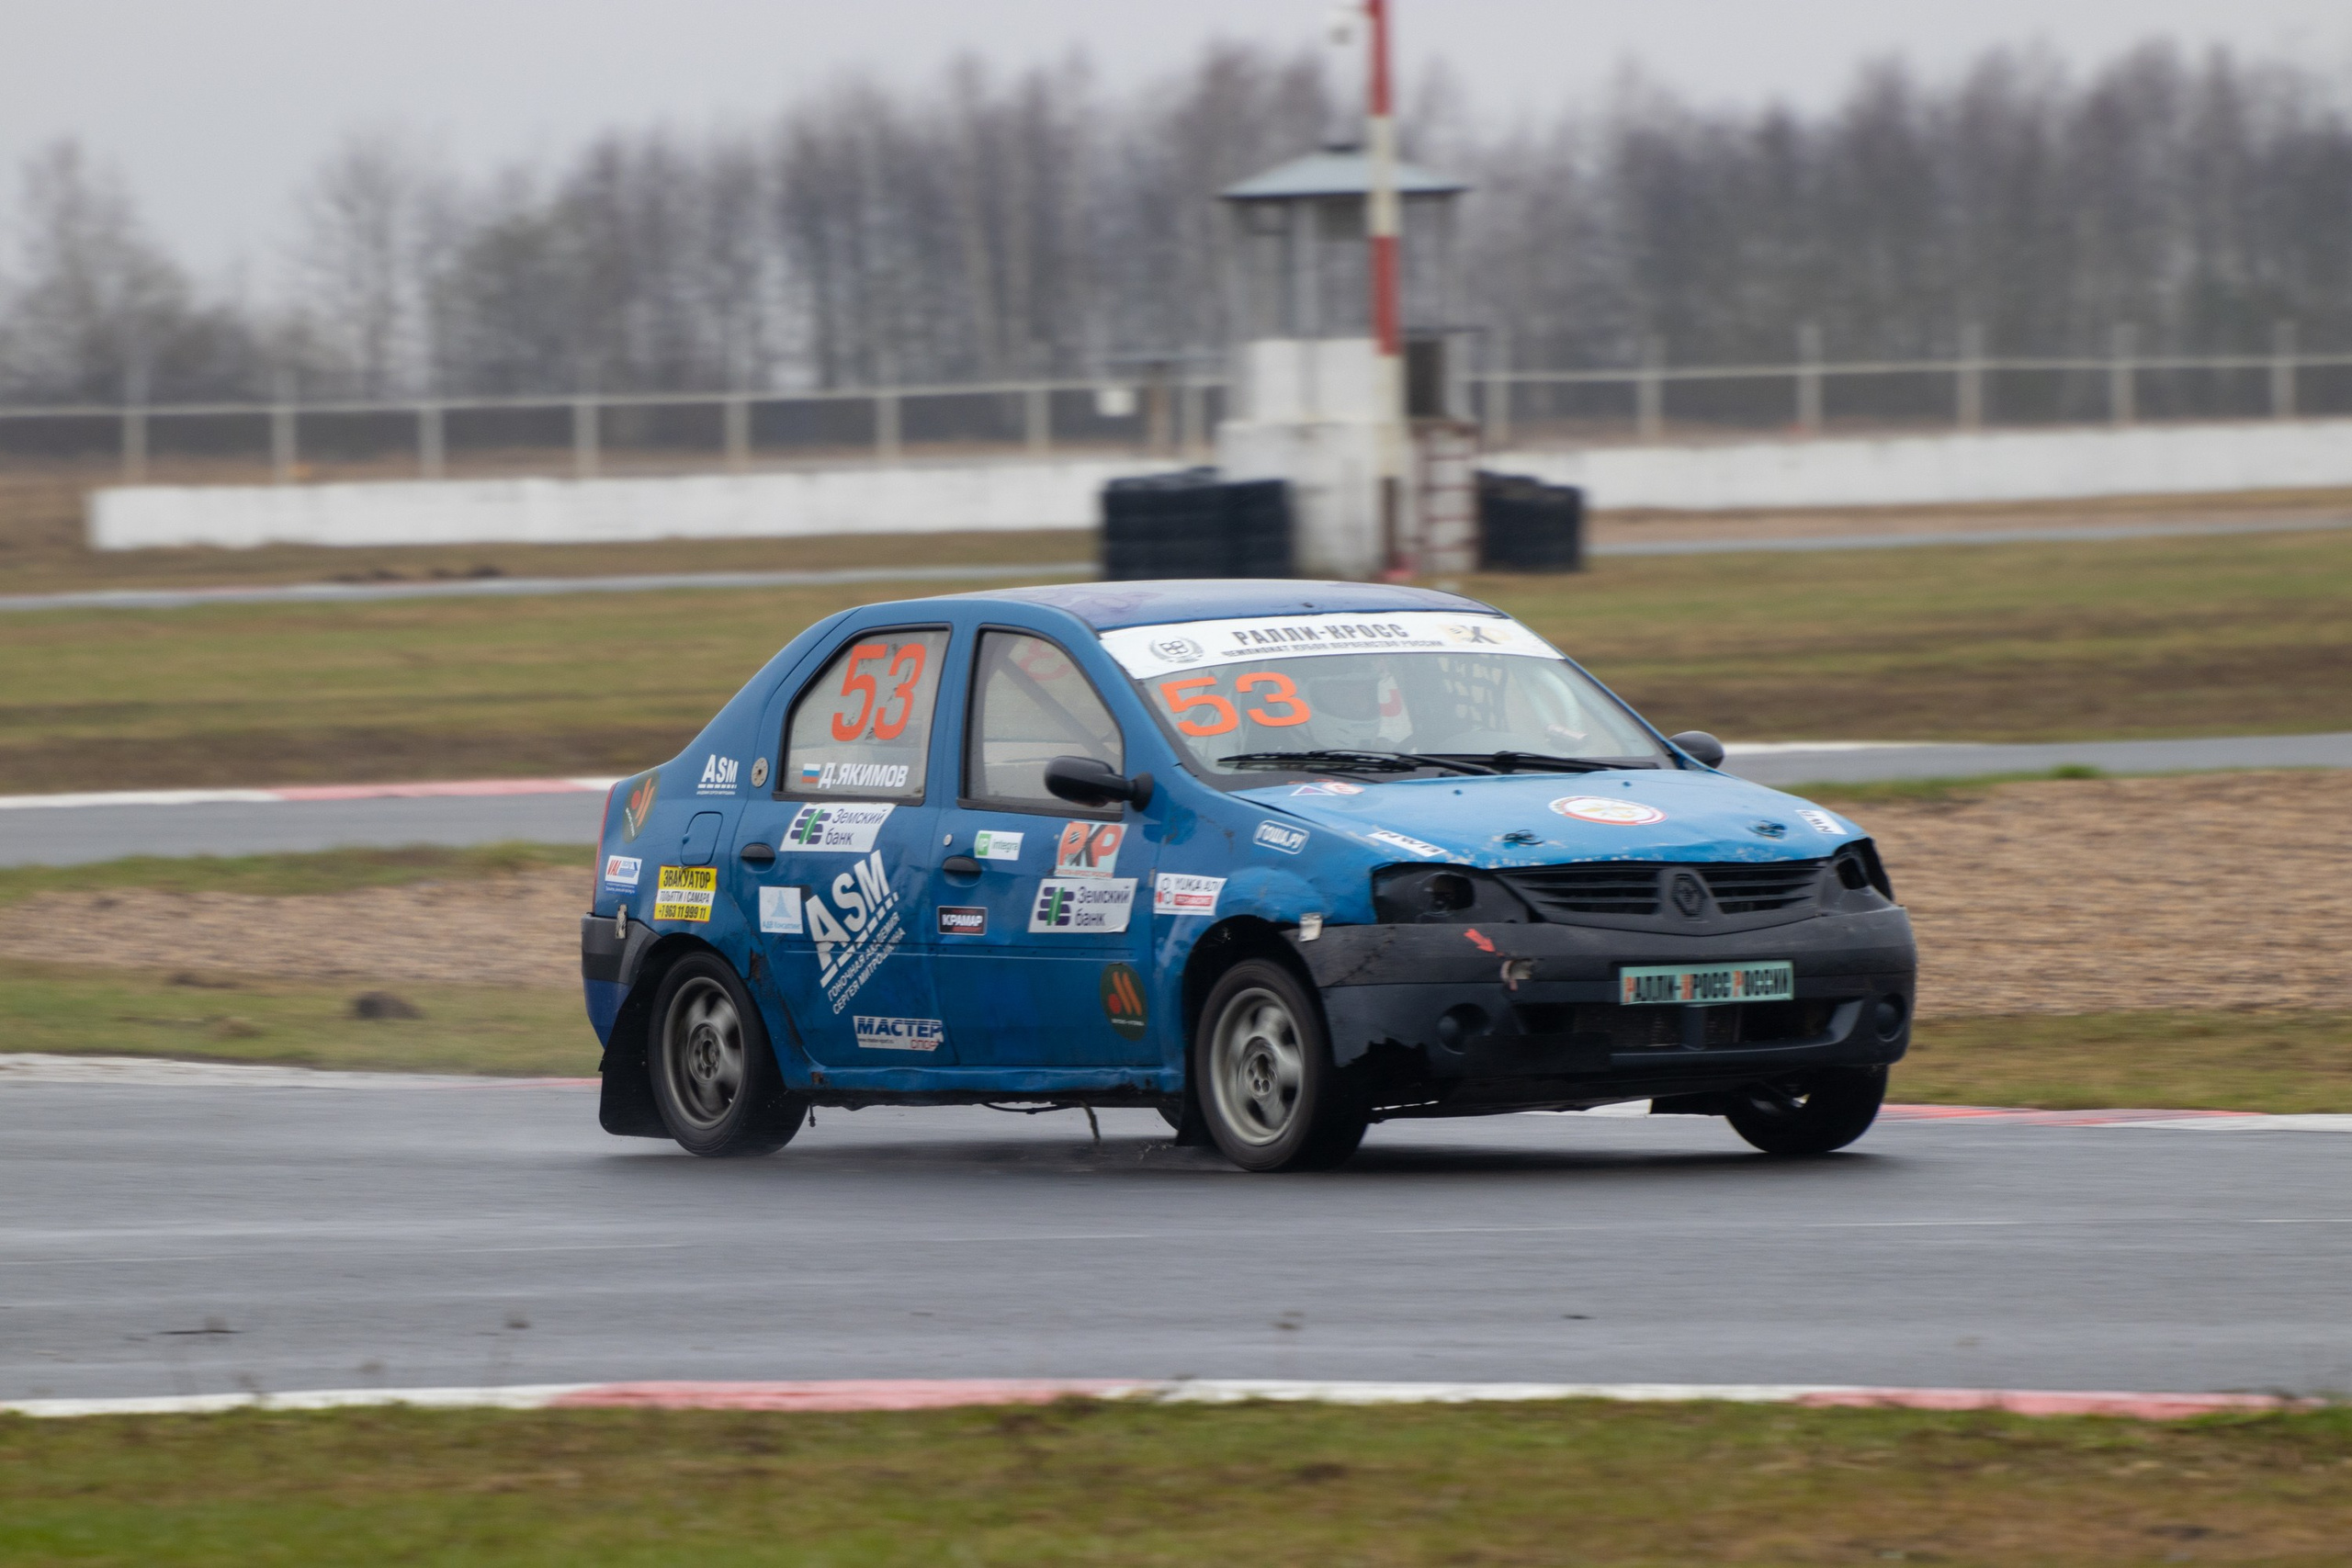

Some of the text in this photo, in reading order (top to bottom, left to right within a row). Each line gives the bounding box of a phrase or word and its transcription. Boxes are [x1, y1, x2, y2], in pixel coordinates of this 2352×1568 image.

[1231, 624, 1409, 646] РАЛЛИ-КРОСС
[831, 642, 927, 742] 53
[1159, 671, 1312, 737] 53
[701, 753, 739, 783] ASM
[818, 761, 910, 789] Д.ЯКИМОВ
[831, 808, 888, 825] Земский
[825, 828, 854, 845] банк
[663, 869, 711, 888] ЭВАКУАТОР
[1076, 885, 1131, 904] Земский
[805, 850, 891, 972] ASM
[941, 914, 983, 927] КРАМАР
[1075, 908, 1106, 927] банк
[828, 953, 865, 1001] ГОНОЧНАЯ
[832, 979, 860, 1015] СЕРГЕЯ
[857, 1017, 943, 1038] МАСТЕР
